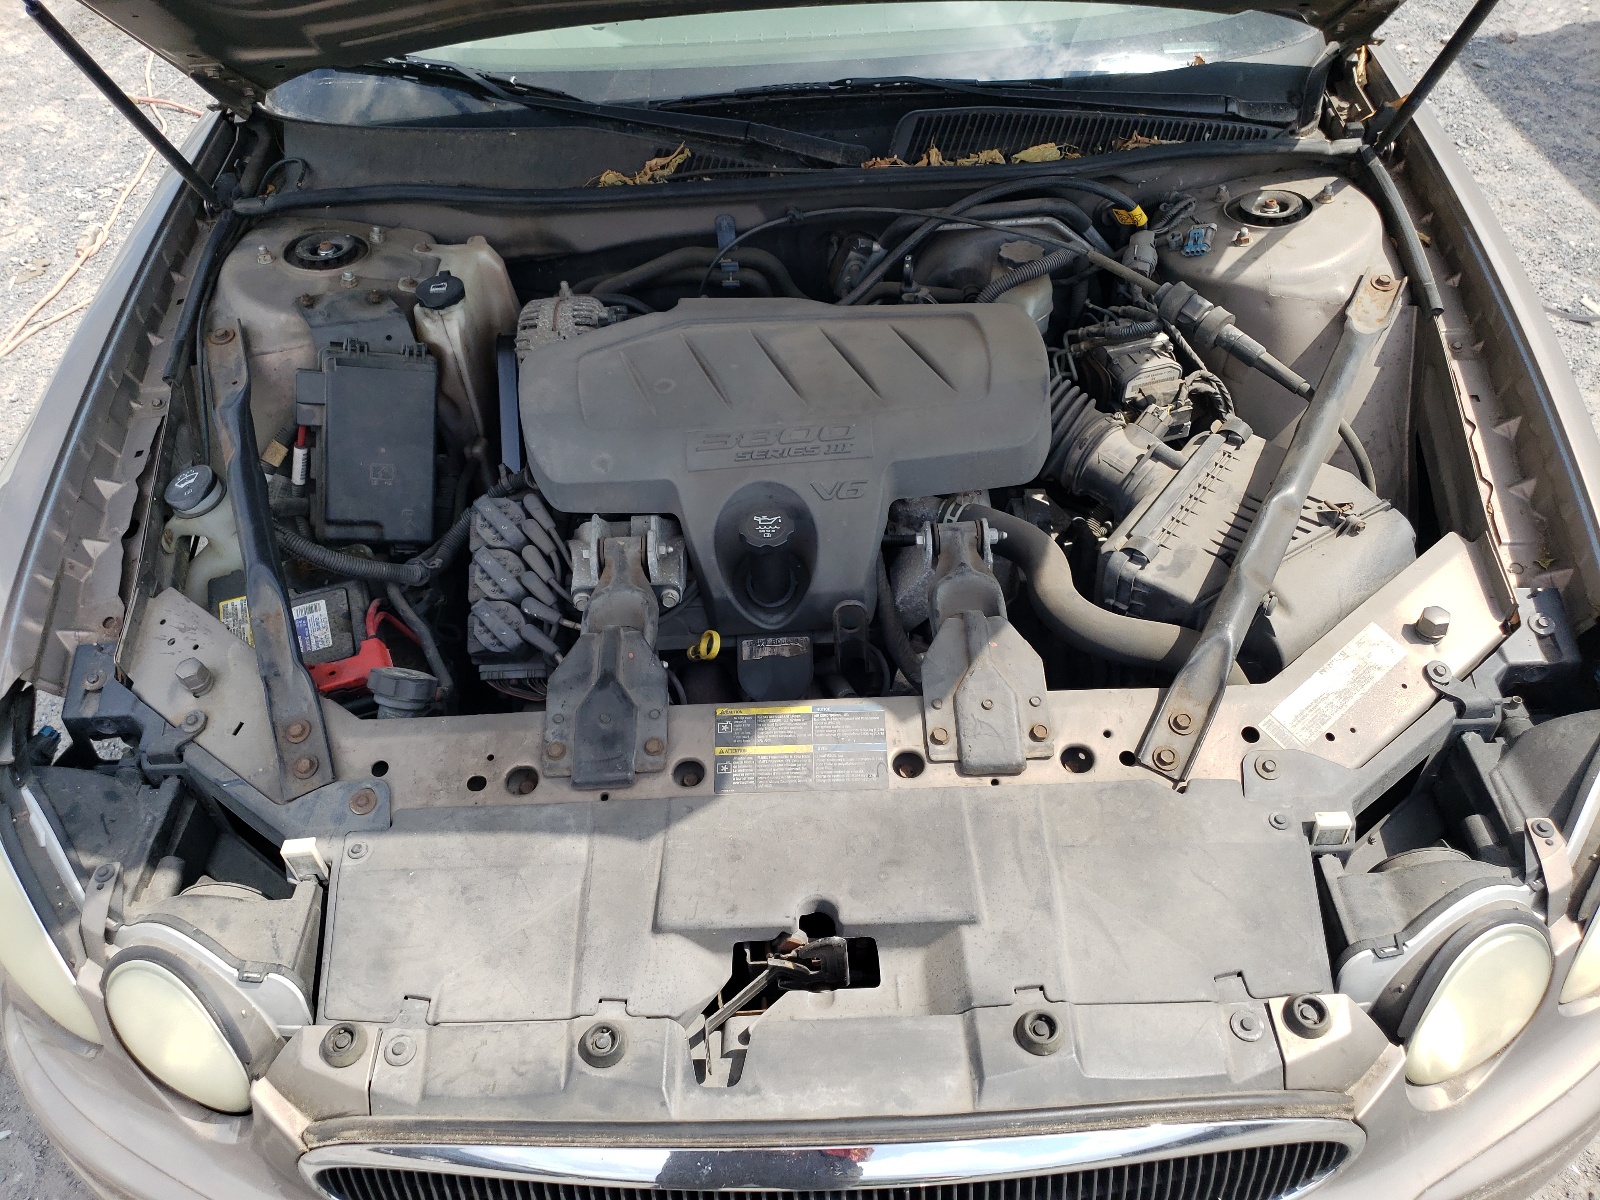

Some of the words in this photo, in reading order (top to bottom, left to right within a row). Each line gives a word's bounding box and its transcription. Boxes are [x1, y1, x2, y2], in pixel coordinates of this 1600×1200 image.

[695, 425, 856, 452] 3800
[734, 445, 822, 462] SERIES
[809, 480, 869, 501] V6
